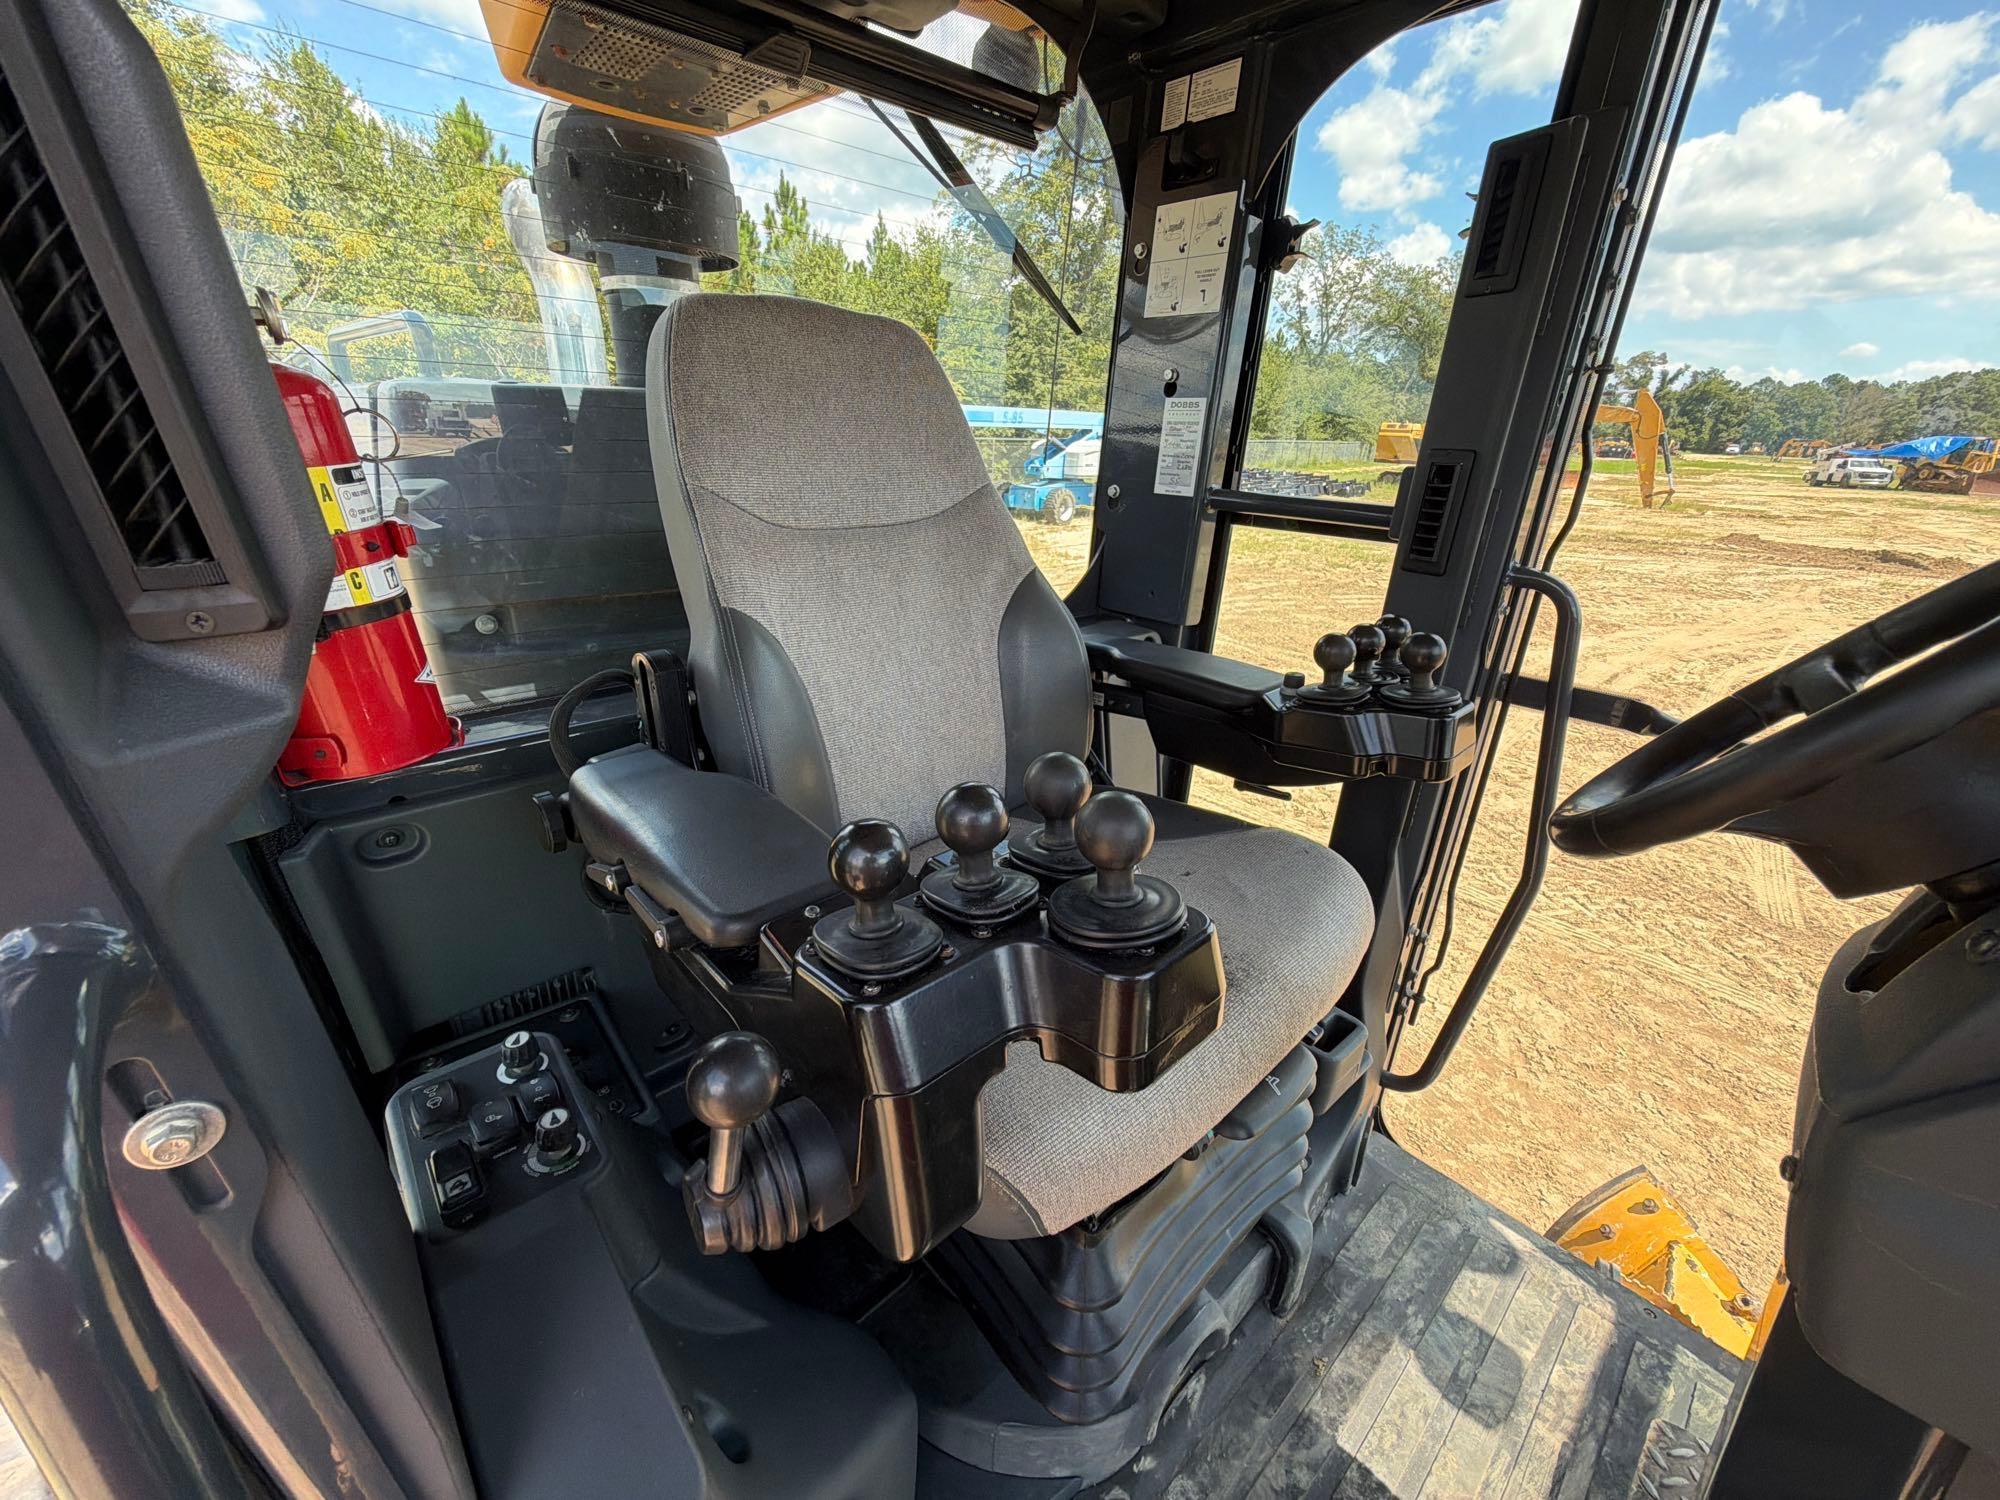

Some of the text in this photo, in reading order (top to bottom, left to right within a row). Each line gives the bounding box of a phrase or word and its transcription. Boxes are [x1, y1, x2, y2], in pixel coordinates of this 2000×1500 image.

[1170, 401, 1200, 409] DOBBS
[1002, 411, 1024, 424] S-85
[319, 483, 333, 502] A
[350, 571, 363, 589] C
